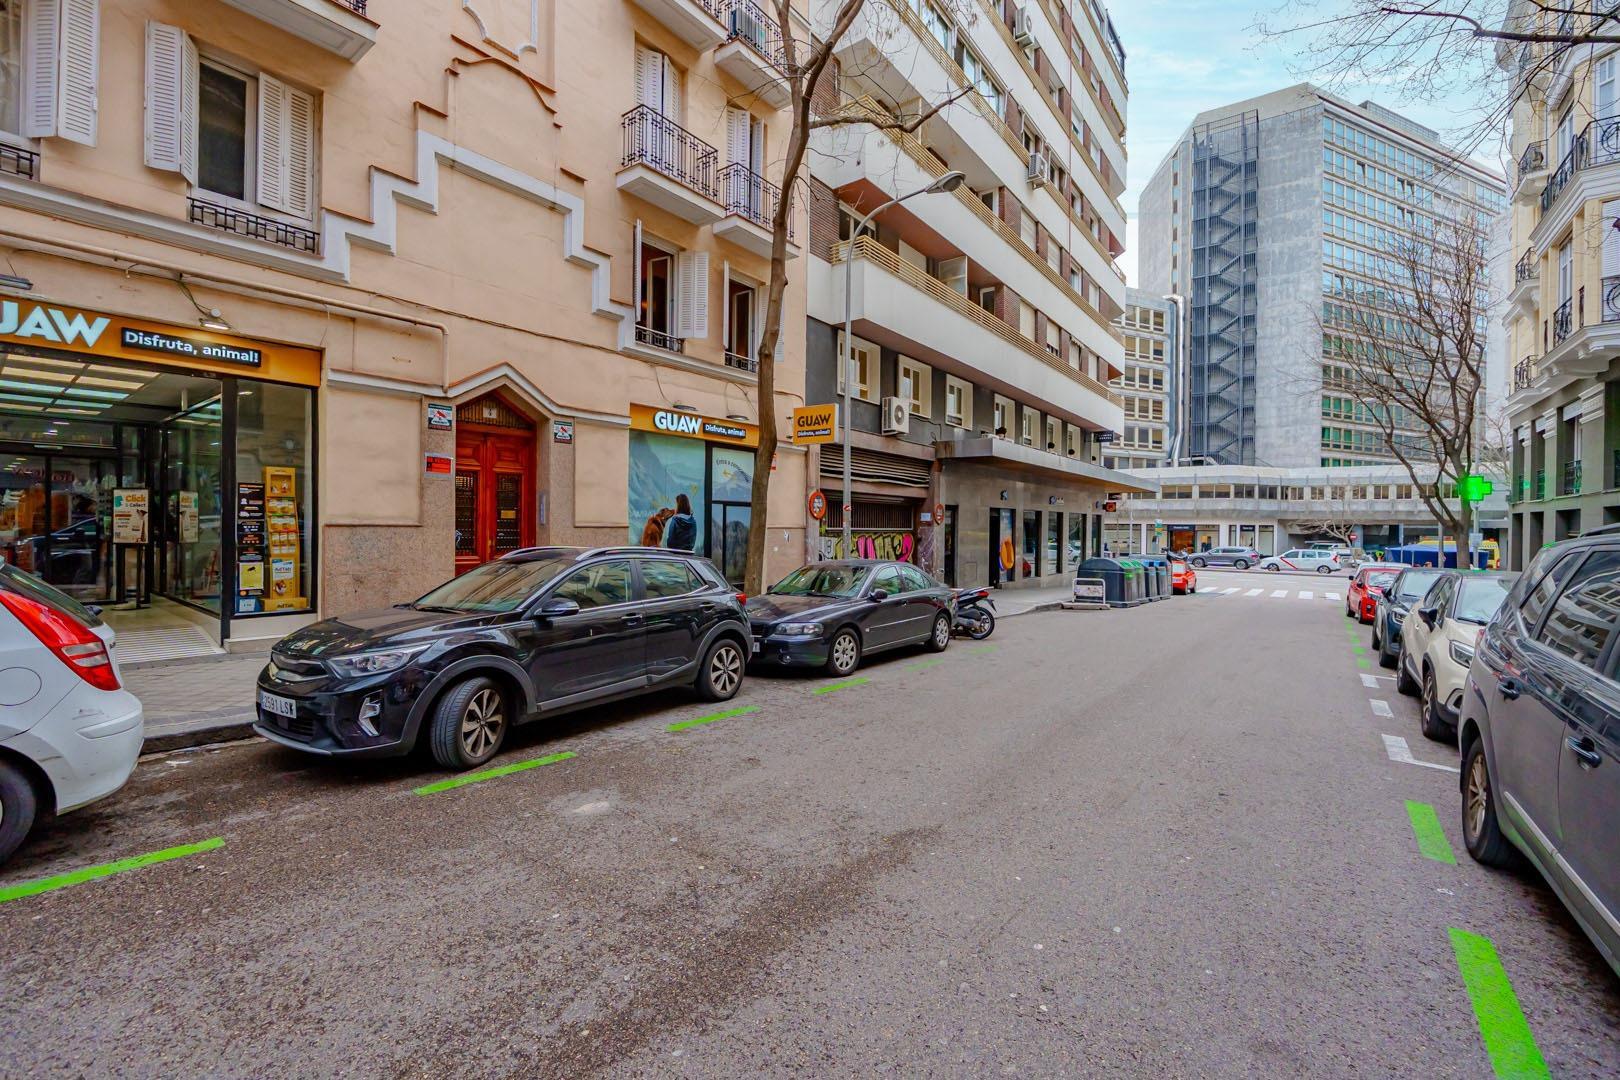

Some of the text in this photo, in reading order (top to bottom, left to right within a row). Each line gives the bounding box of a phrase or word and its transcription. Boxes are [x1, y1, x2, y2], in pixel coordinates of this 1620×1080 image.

[125, 330, 259, 363] Disfruta, animal!
[654, 411, 702, 435] GUAW
[705, 424, 727, 435] Disfruta,
[797, 413, 832, 427] GUAW
